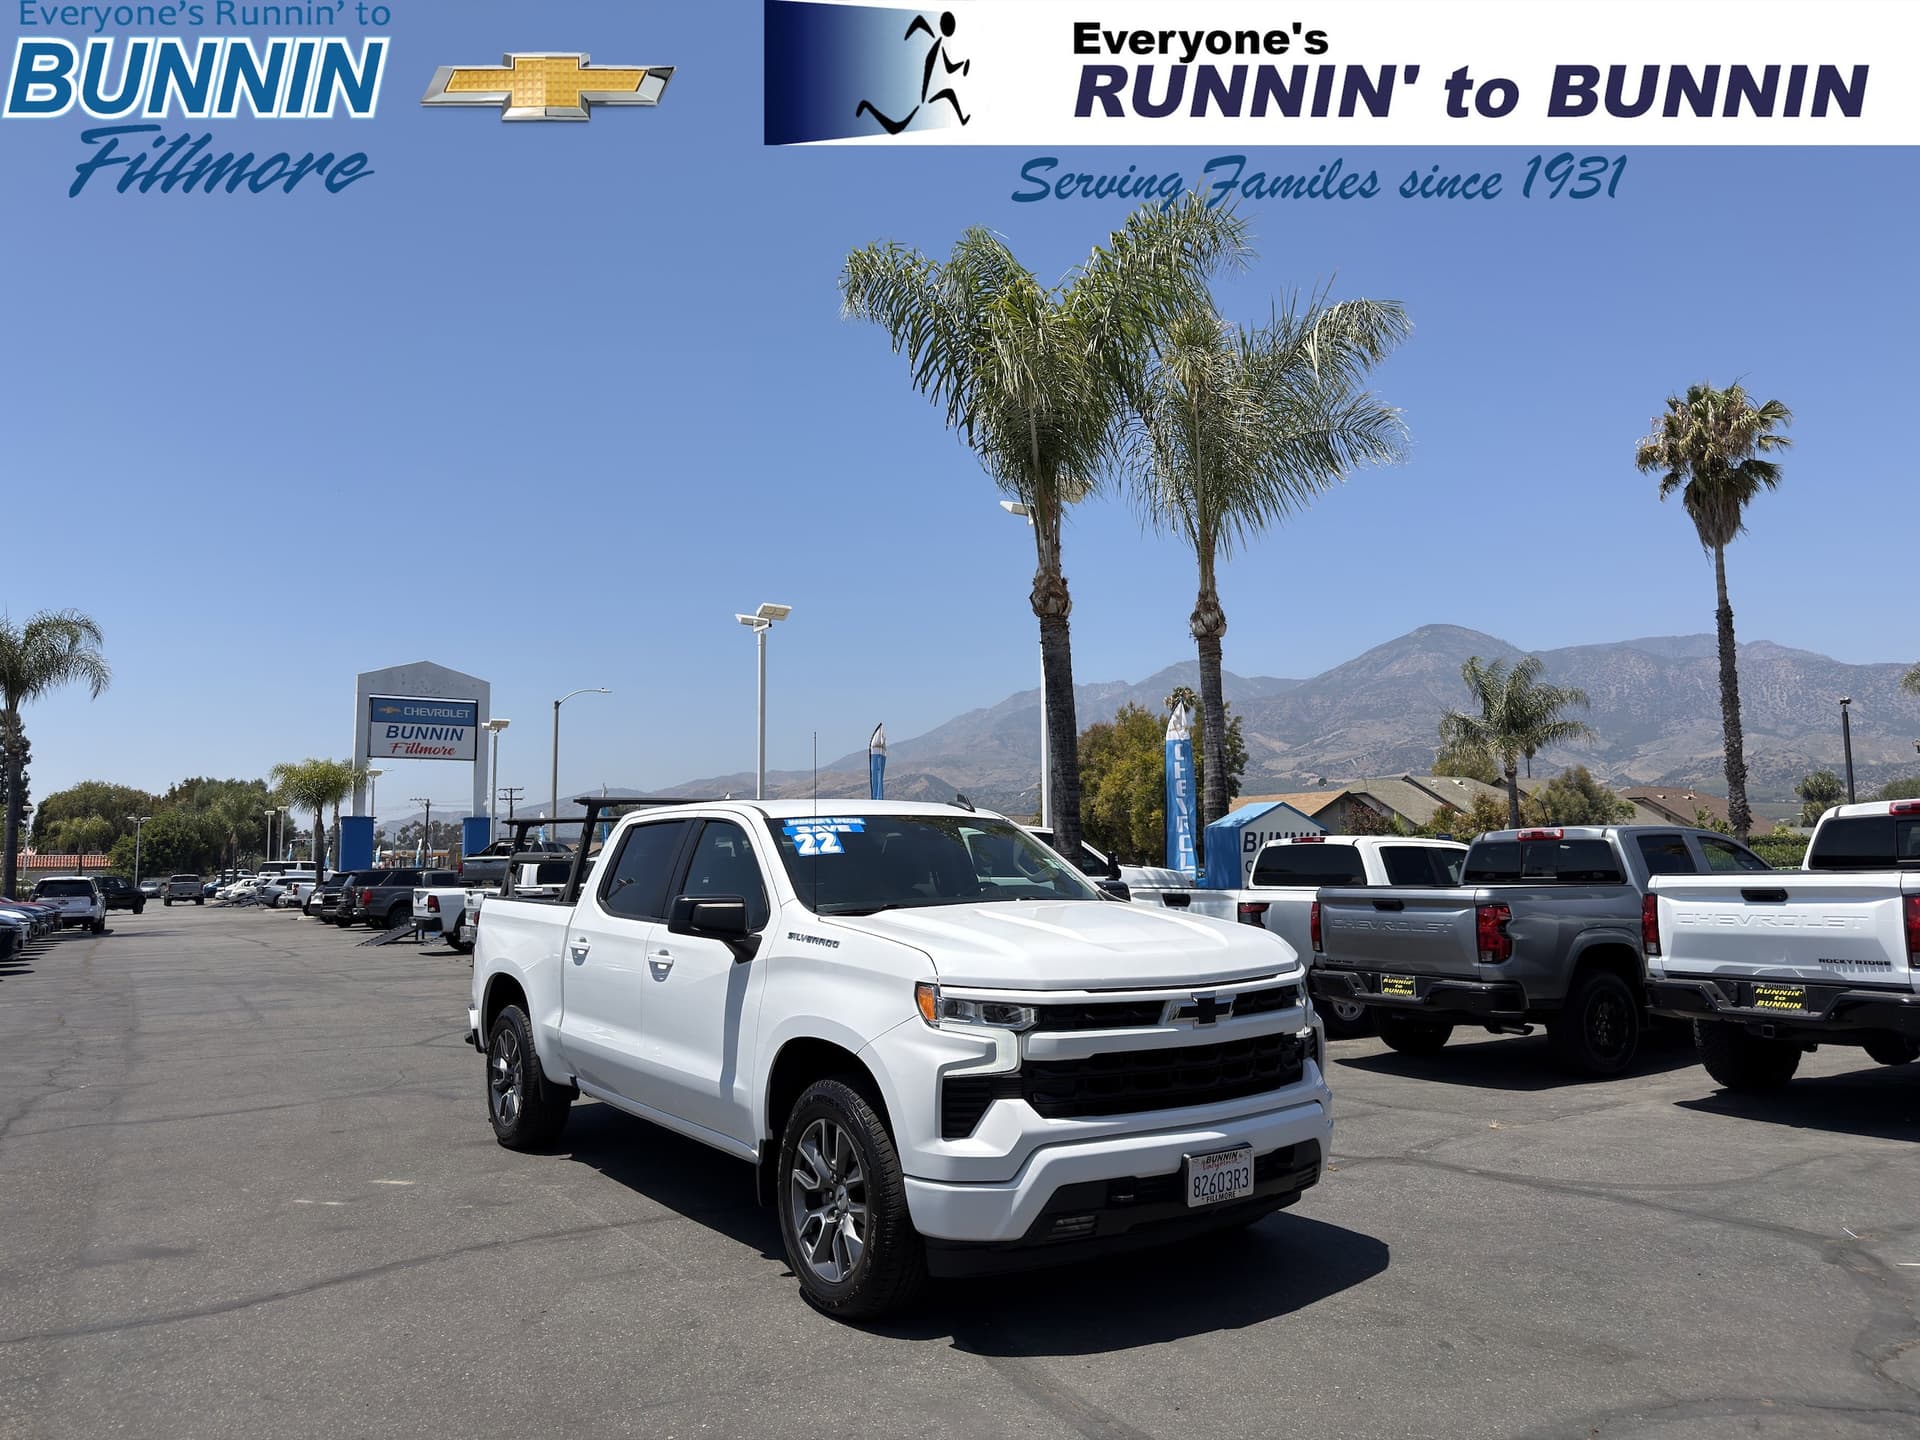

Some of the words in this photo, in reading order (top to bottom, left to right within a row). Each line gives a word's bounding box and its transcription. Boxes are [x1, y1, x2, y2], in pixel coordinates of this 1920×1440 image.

[404, 706, 470, 718] CHEVROLET
[385, 725, 465, 742] BUNNIN
[389, 742, 457, 757] Fillmore
[794, 832, 841, 855] 22
[1676, 912, 1870, 929] CHEVROLET
[787, 932, 841, 949] SILVERADO
[1755, 988, 1804, 997] RUNNIN'
[1756, 1000, 1803, 1009] BUNNIN
[1205, 1151, 1239, 1164] BUNNIN
[1193, 1167, 1249, 1198] 82603R3
[1206, 1190, 1237, 1204] FILLMORE
